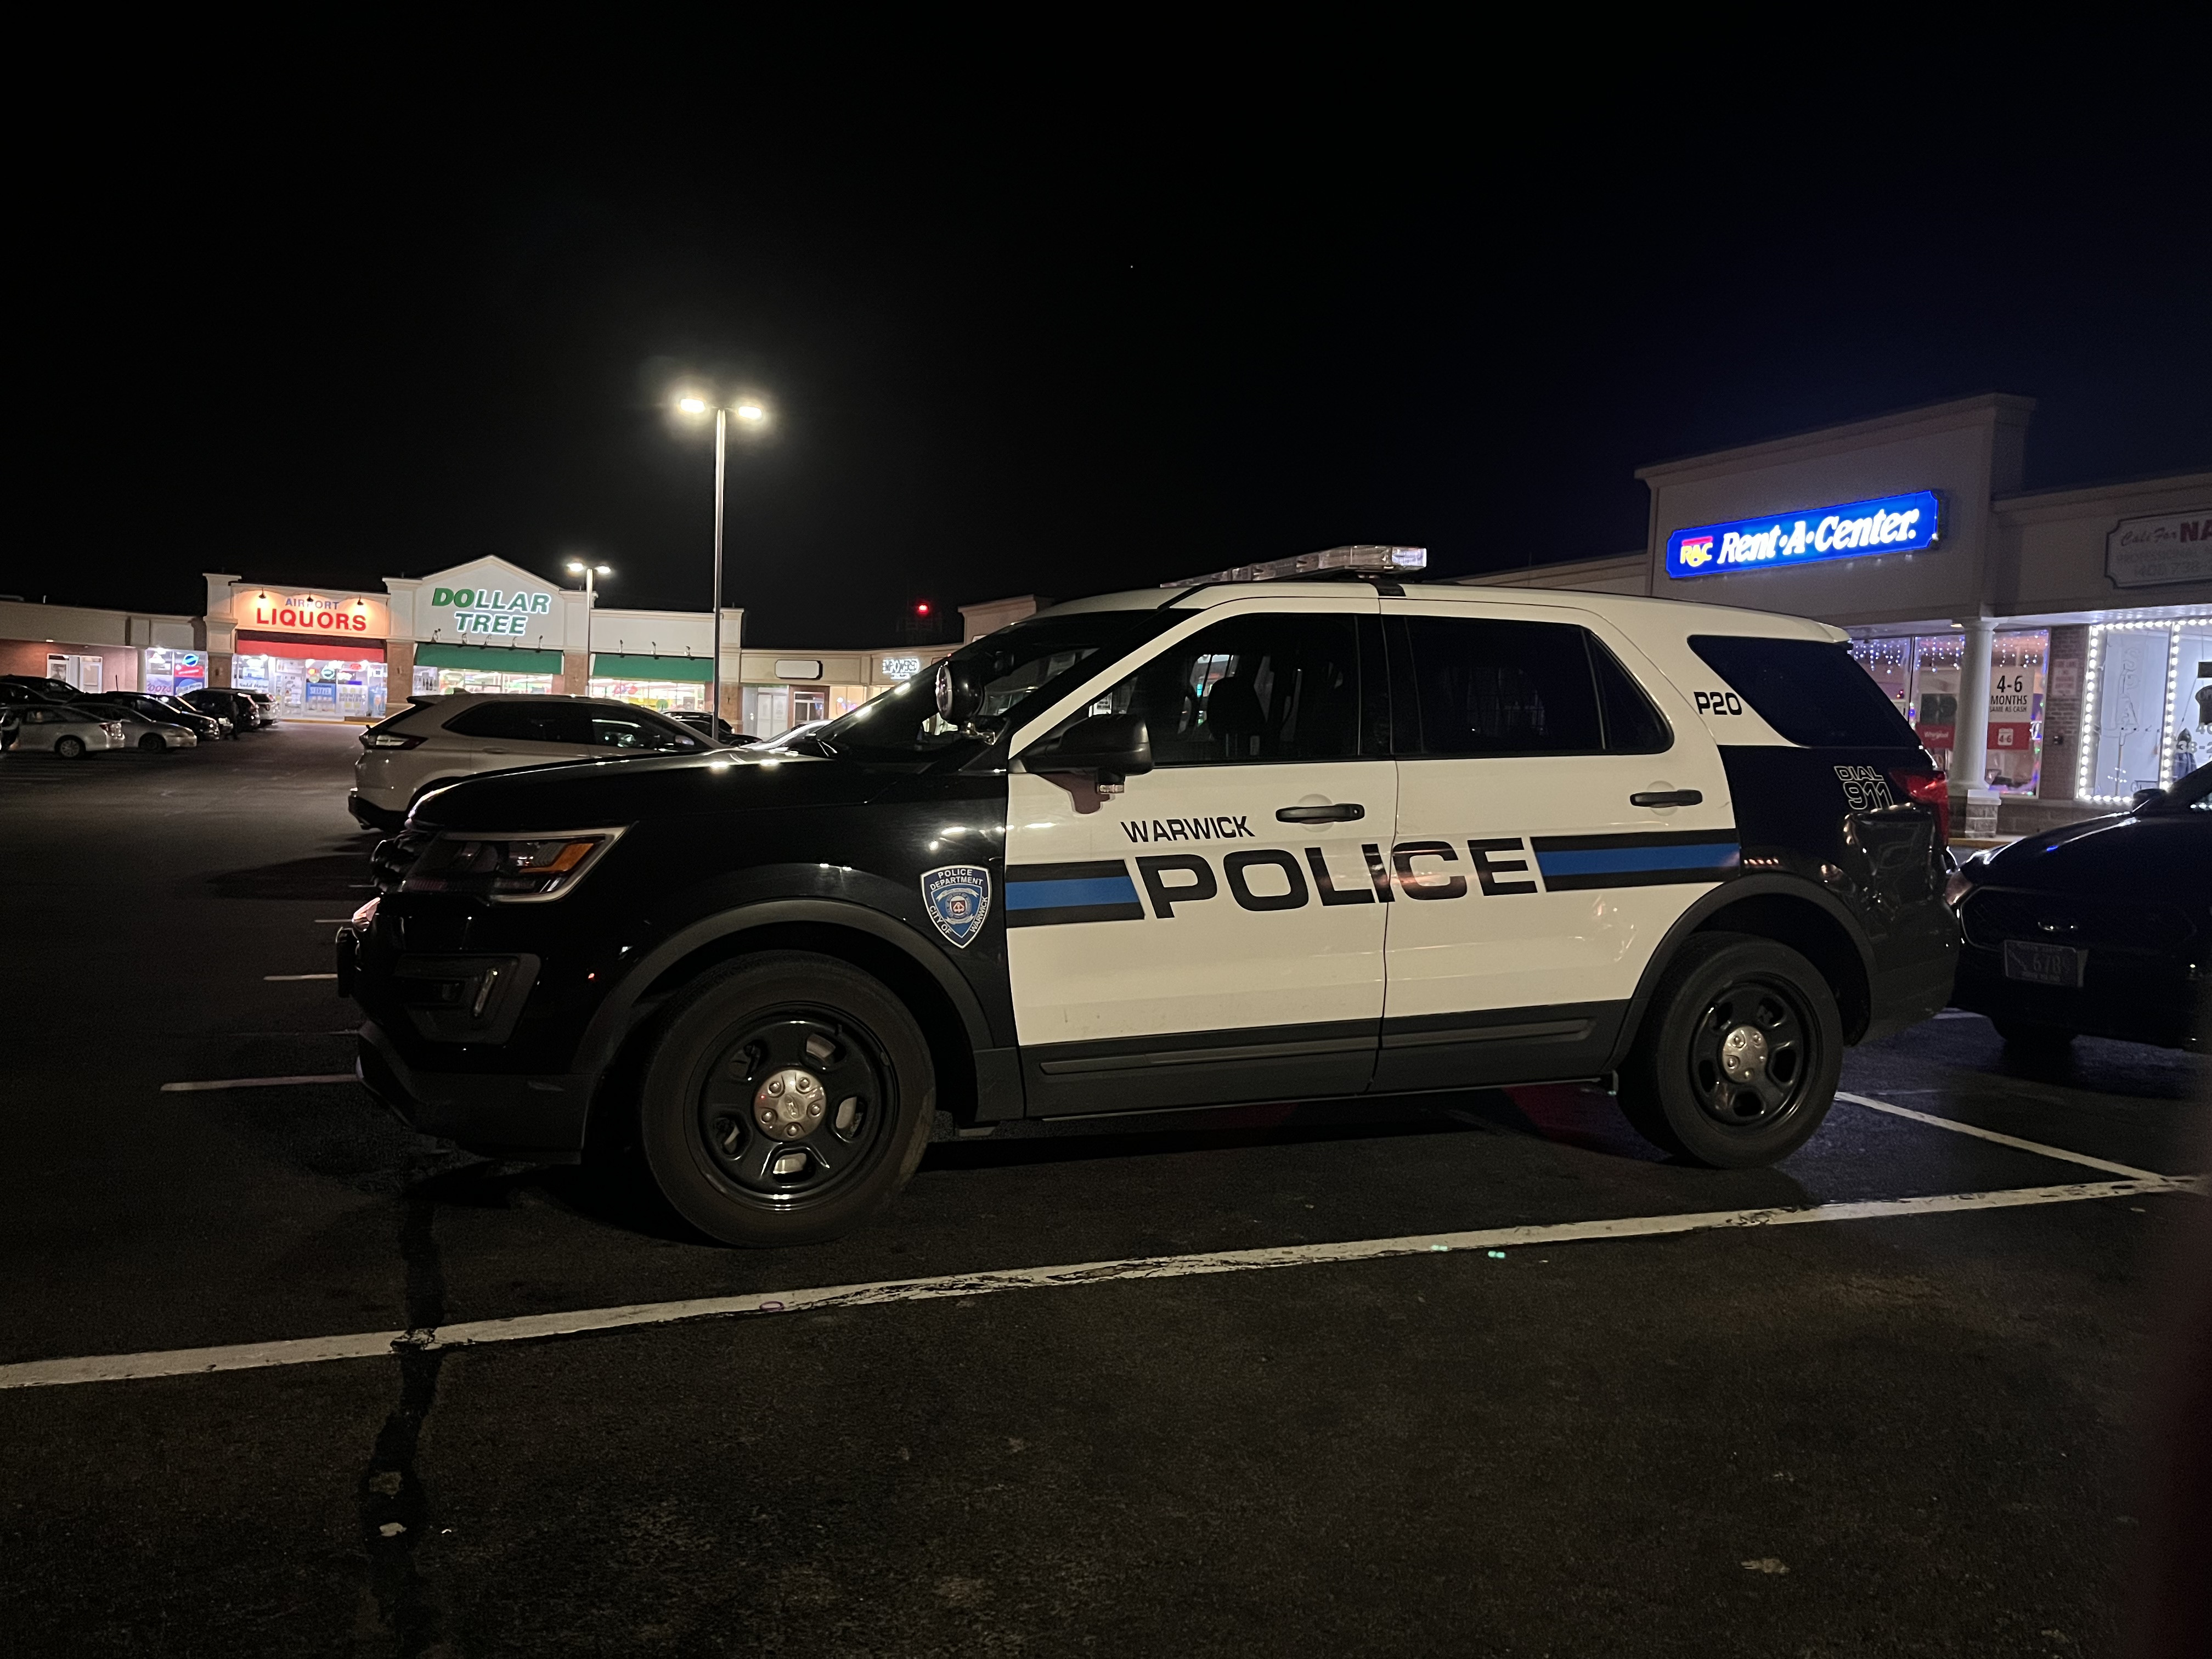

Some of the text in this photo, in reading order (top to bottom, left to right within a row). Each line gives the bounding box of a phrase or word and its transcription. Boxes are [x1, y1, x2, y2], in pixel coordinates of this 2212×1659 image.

[1679, 542, 1713, 567] RAC
[285, 597, 340, 610] AIRPORT
[432, 589, 551, 613] DOLLAR
[256, 607, 366, 631] LIQUORS
[454, 611, 528, 636] TREE
[1996, 675, 2023, 693] 4-6
[1694, 691, 1743, 716] P20
[1990, 695, 2027, 705] MONTHS
[1833, 765, 1884, 781] DIAL
[1842, 781, 1894, 810] 911
[1121, 815, 1256, 844] WARWICK
[929, 876, 984, 890] DEPARTMENT
[937, 868, 973, 879] POLICE
[1134, 840, 1538, 919] POLICE
[929, 905, 953, 934] CITY OF
[969, 896, 988, 933] WARWICK
